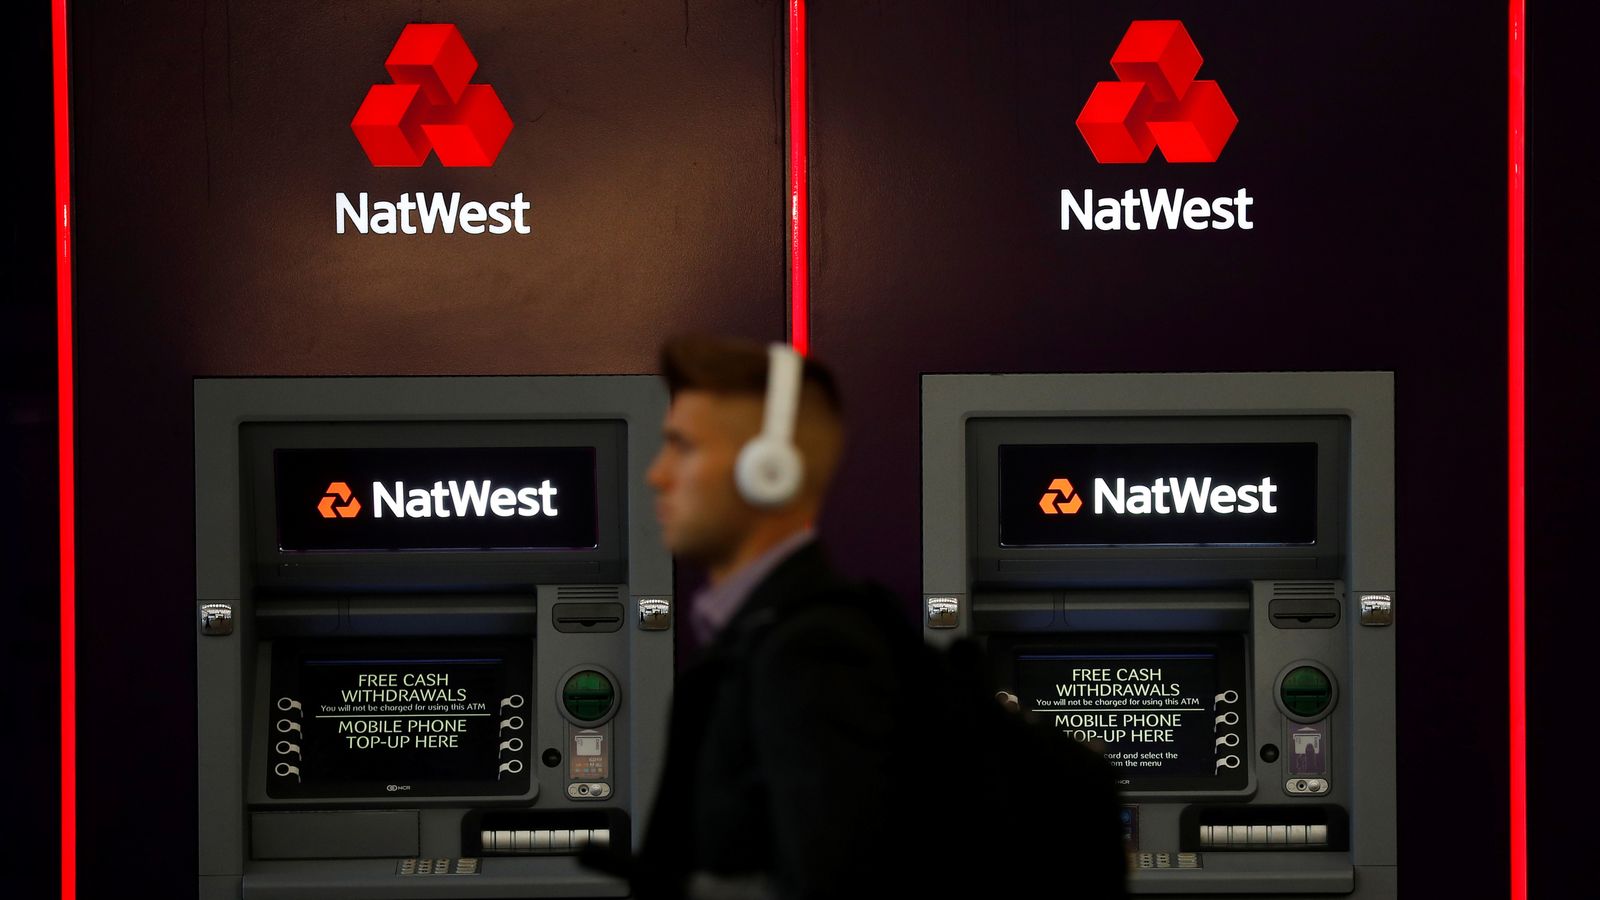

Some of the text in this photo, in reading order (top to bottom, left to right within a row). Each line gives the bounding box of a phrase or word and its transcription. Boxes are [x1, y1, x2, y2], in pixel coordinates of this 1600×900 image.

[335, 191, 531, 235] NatWest
[1060, 187, 1254, 231] NatWest
[372, 479, 559, 519] NatWest
[1094, 476, 1278, 515] NatWest
[358, 673, 449, 687] FREE CASH
[1072, 668, 1162, 682] FREE CASH
[341, 688, 467, 703] WITHDRAWALS
[1055, 683, 1180, 697] WITHDRAWALS
[320, 702, 486, 713] You will not be charged for using this ATM
[1036, 698, 1052, 706] You
[1052, 698, 1067, 706] will
[1082, 698, 1093, 706] be
[1094, 698, 1128, 708] charged
[1129, 697, 1141, 706] for
[1141, 697, 1163, 707] using
[1164, 697, 1179, 706] this
[1180, 697, 1200, 705] ATM
[338, 719, 467, 734] MOBILE PHONE
[1055, 713, 1182, 728] MOBILE PHONE
[345, 734, 459, 749] TOP-UP HERE
[1131, 729, 1175, 743] HERE
[1122, 751, 1139, 760] and
[1140, 751, 1164, 760] select
[1165, 751, 1179, 760] the
[1124, 759, 1138, 767] the
